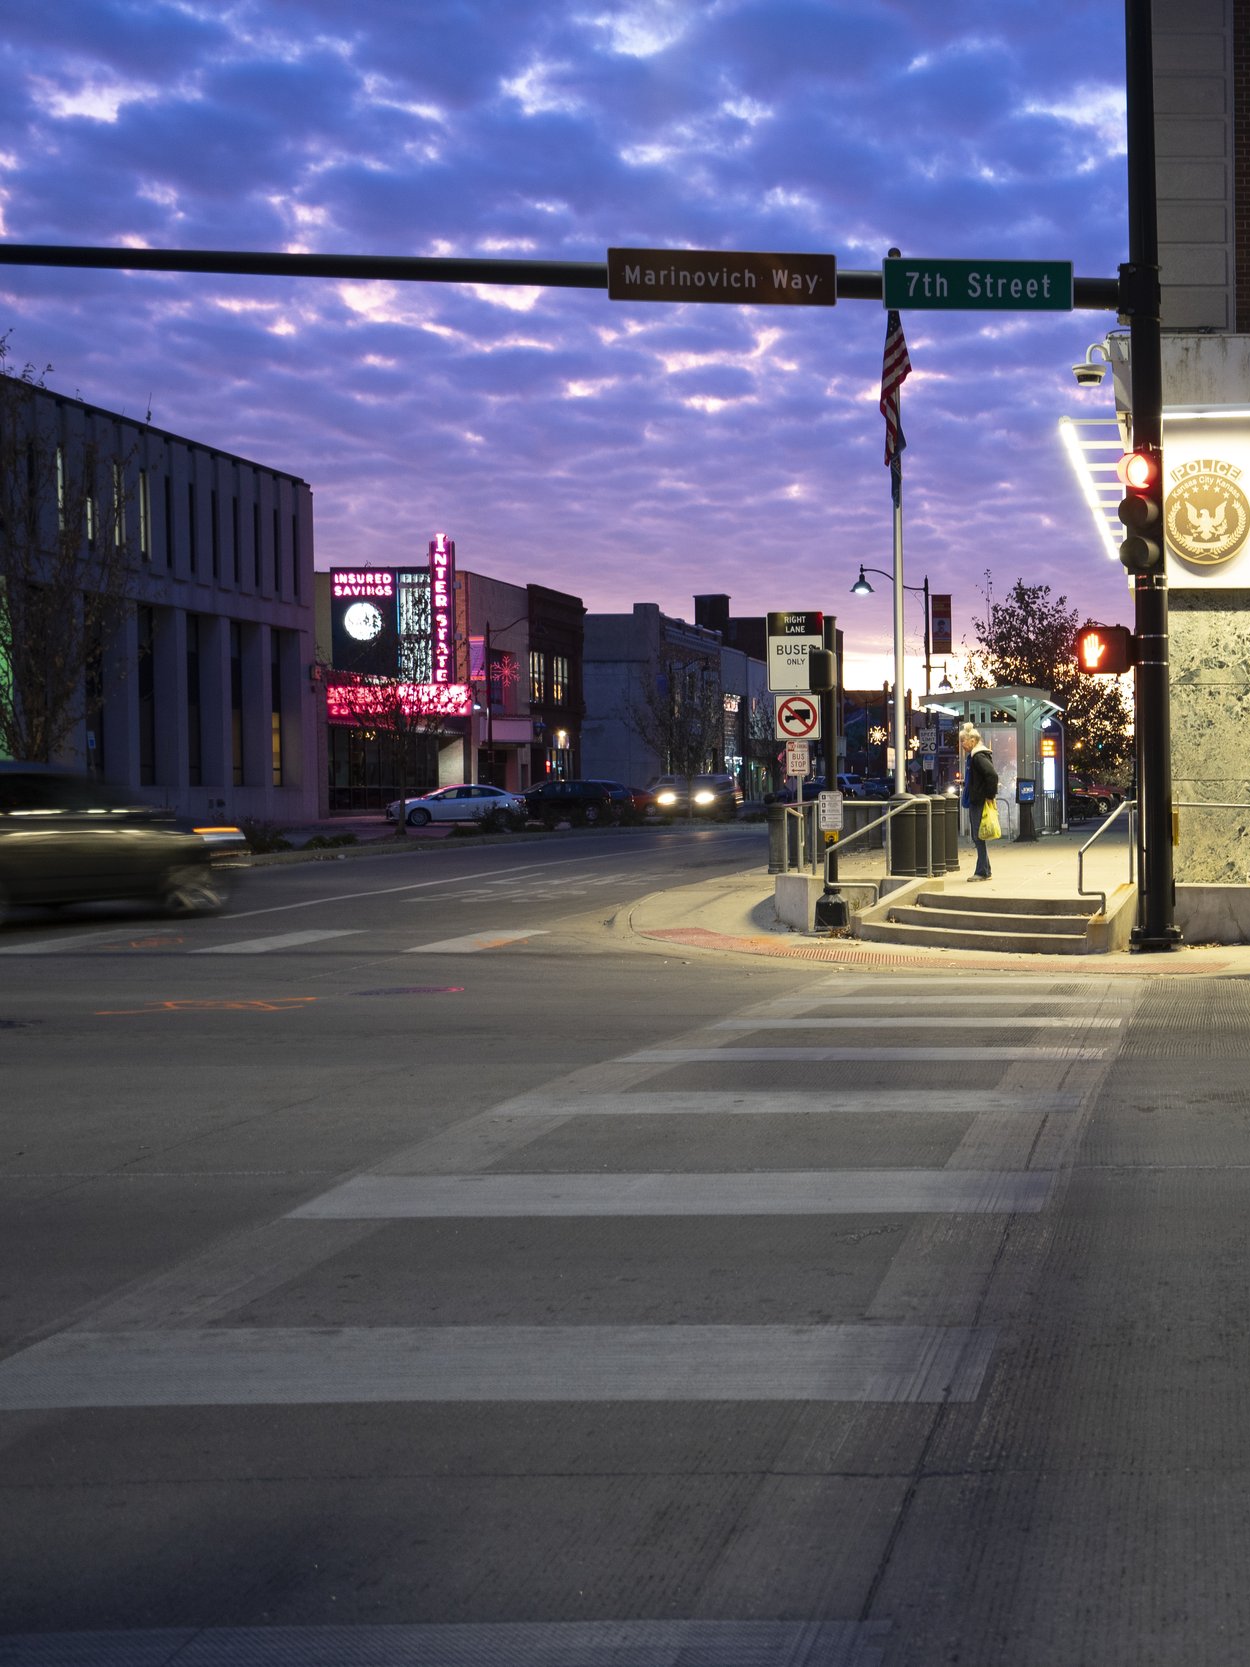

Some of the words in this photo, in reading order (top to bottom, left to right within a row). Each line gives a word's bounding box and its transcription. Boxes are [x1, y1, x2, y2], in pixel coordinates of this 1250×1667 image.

[624, 264, 756, 288] Marinovich
[772, 269, 818, 294] Way
[906, 272, 948, 297] 7th
[967, 272, 1051, 298] Street
[1173, 460, 1241, 482] POLICE
[1172, 479, 1197, 499] Kansas
[1199, 476, 1214, 485] City
[1216, 478, 1240, 499] Kansas
[334, 573, 392, 584] INSURED
[334, 585, 393, 596] SAVINGS
[784, 616, 806, 624] RIGHT
[786, 658, 806, 666] ONLY
[921, 742, 937, 752] 20
[792, 753, 805, 761] BUS
